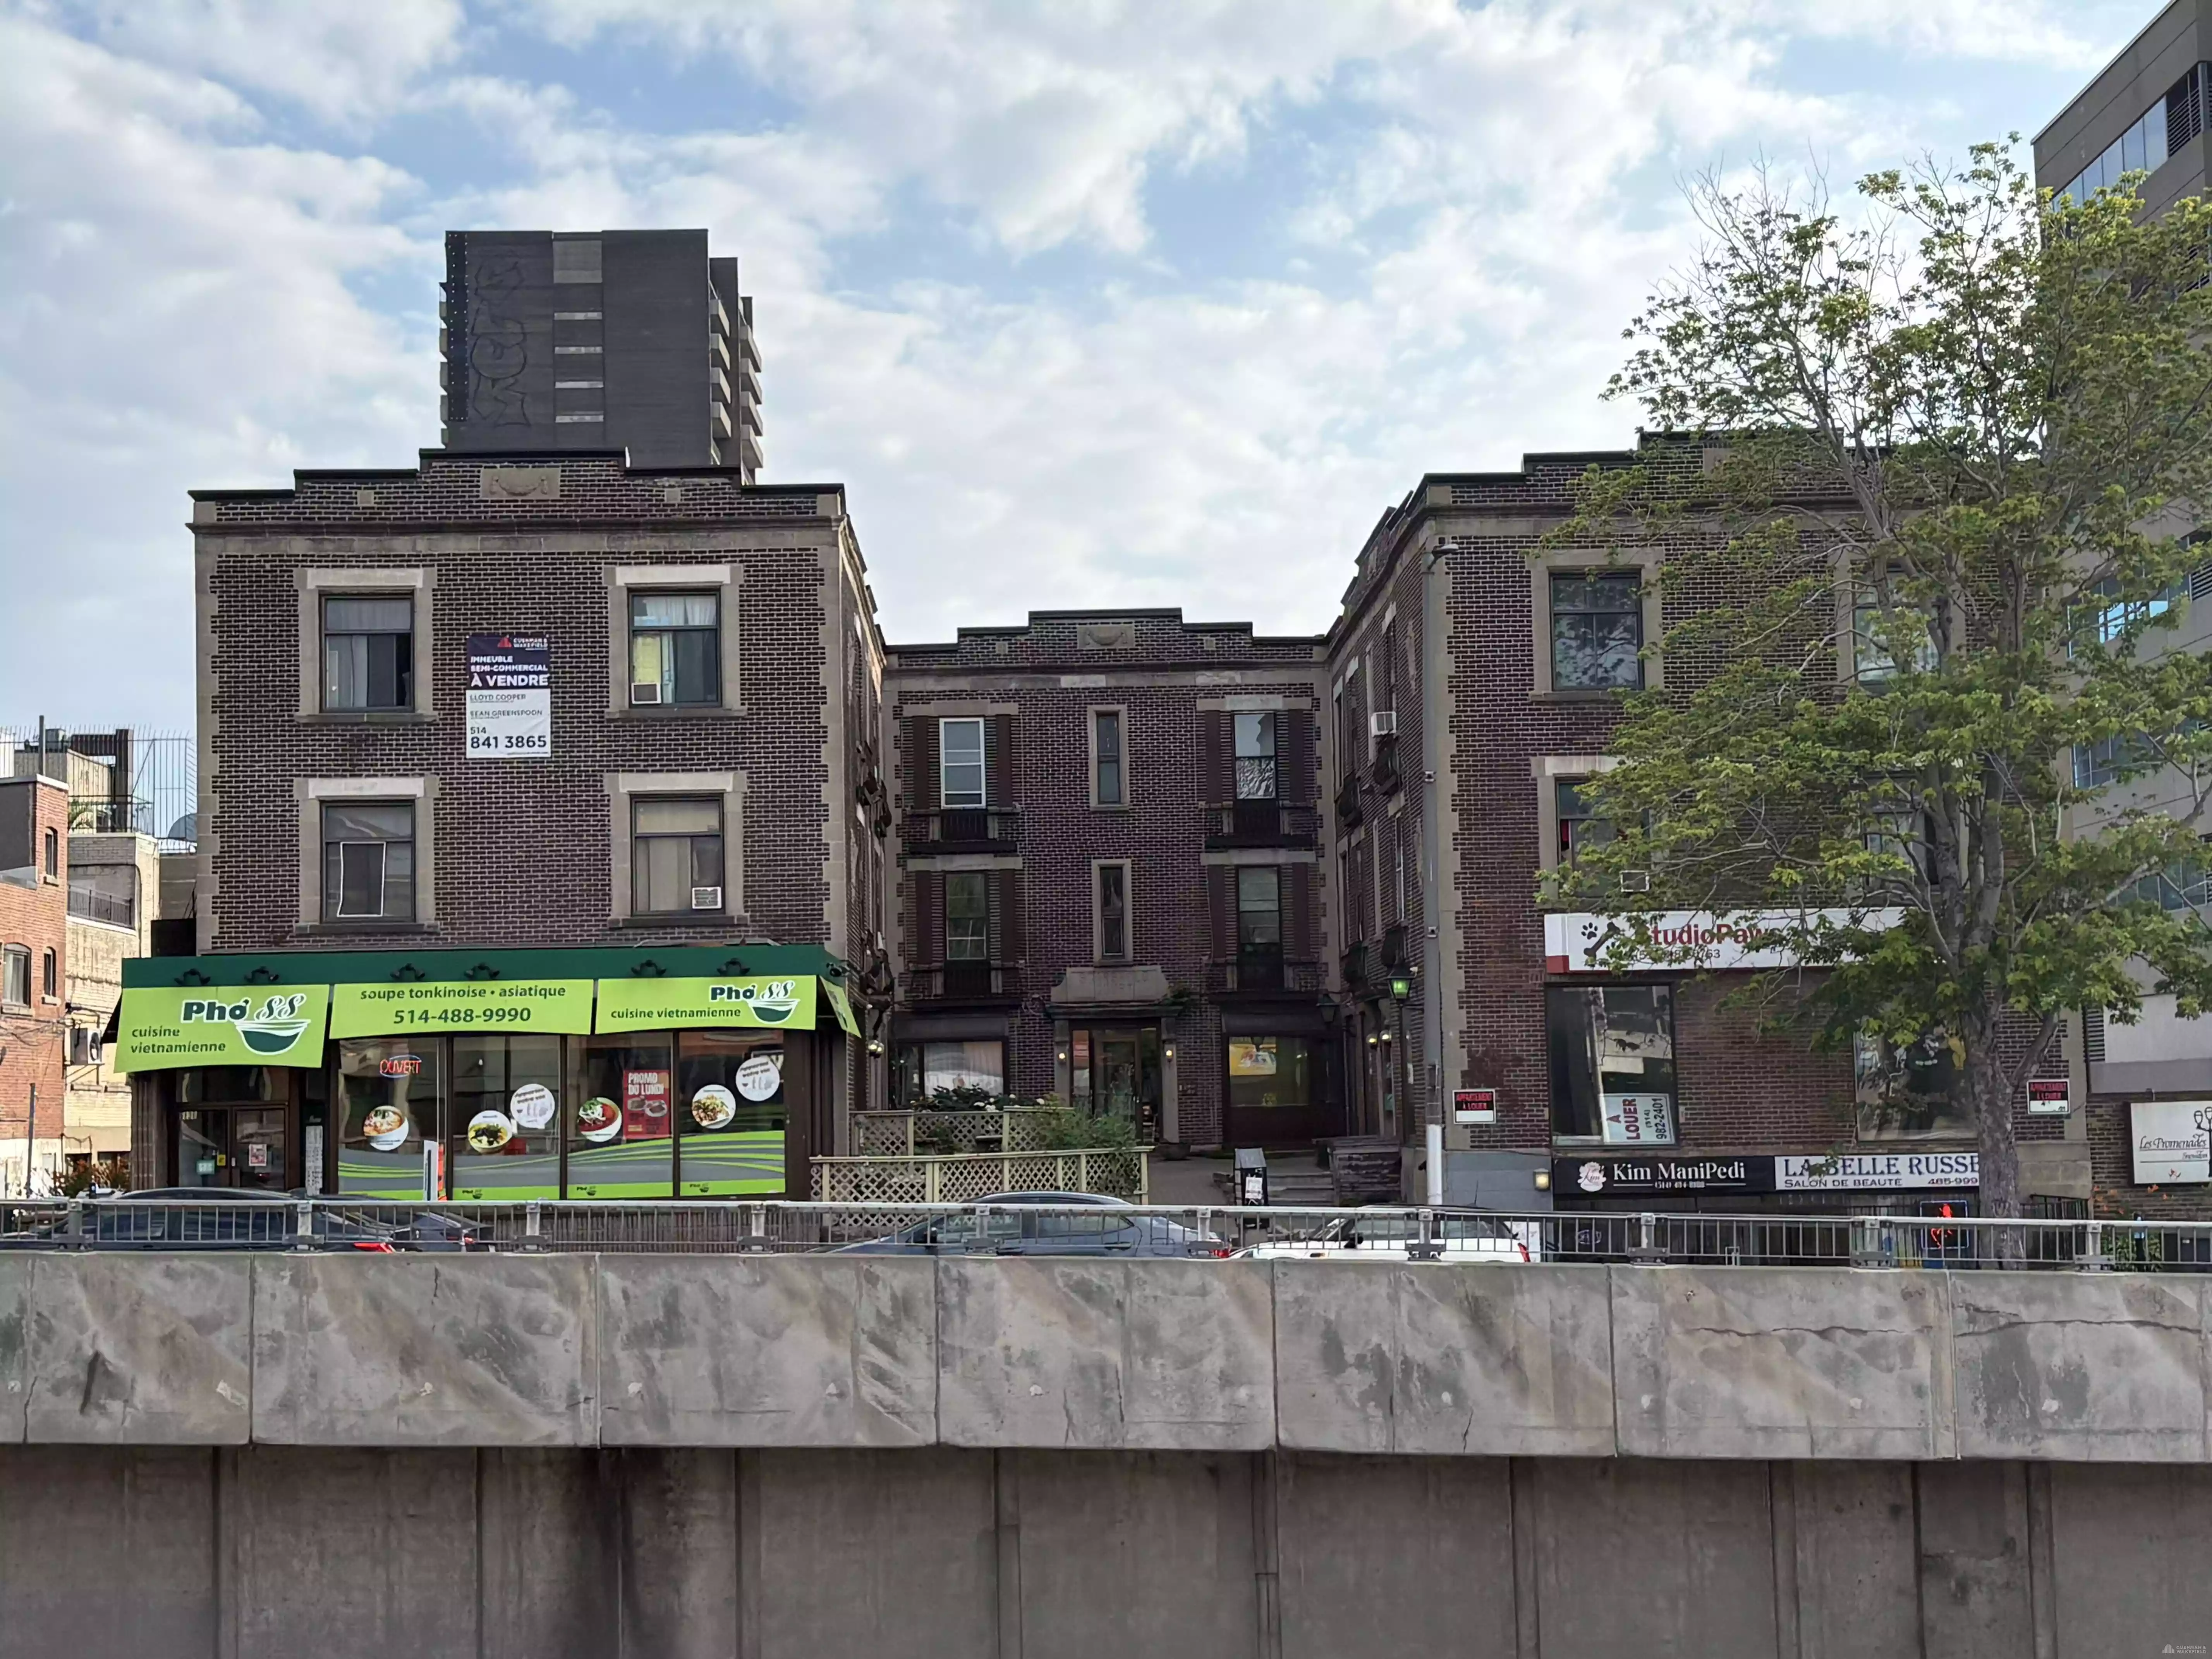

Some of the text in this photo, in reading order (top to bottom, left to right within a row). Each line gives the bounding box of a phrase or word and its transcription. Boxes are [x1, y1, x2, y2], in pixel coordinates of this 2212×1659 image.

[471, 673, 548, 687] À VENDRE
[471, 735, 547, 749] 841 3865
[360, 986, 566, 1002] soupe tonkinoise asiatique
[393, 1007, 531, 1024] 514-488-9990
[611, 1007, 741, 1018] cuisine vietnamienne
[132, 1026, 180, 1037] cuisine
[131, 1042, 226, 1053] vietnamienne
[380, 1059, 420, 1074] OUVERT
[628, 1072, 658, 1084] PROMO
[641, 1084, 664, 1095] LUNDI
[1623, 1098, 1640, 1140] LOUER
[1652, 1098, 1667, 1139] 982-2401
[1613, 1161, 1745, 1180] Kim ManiPedi
[1784, 1179, 1827, 1188] SALON
